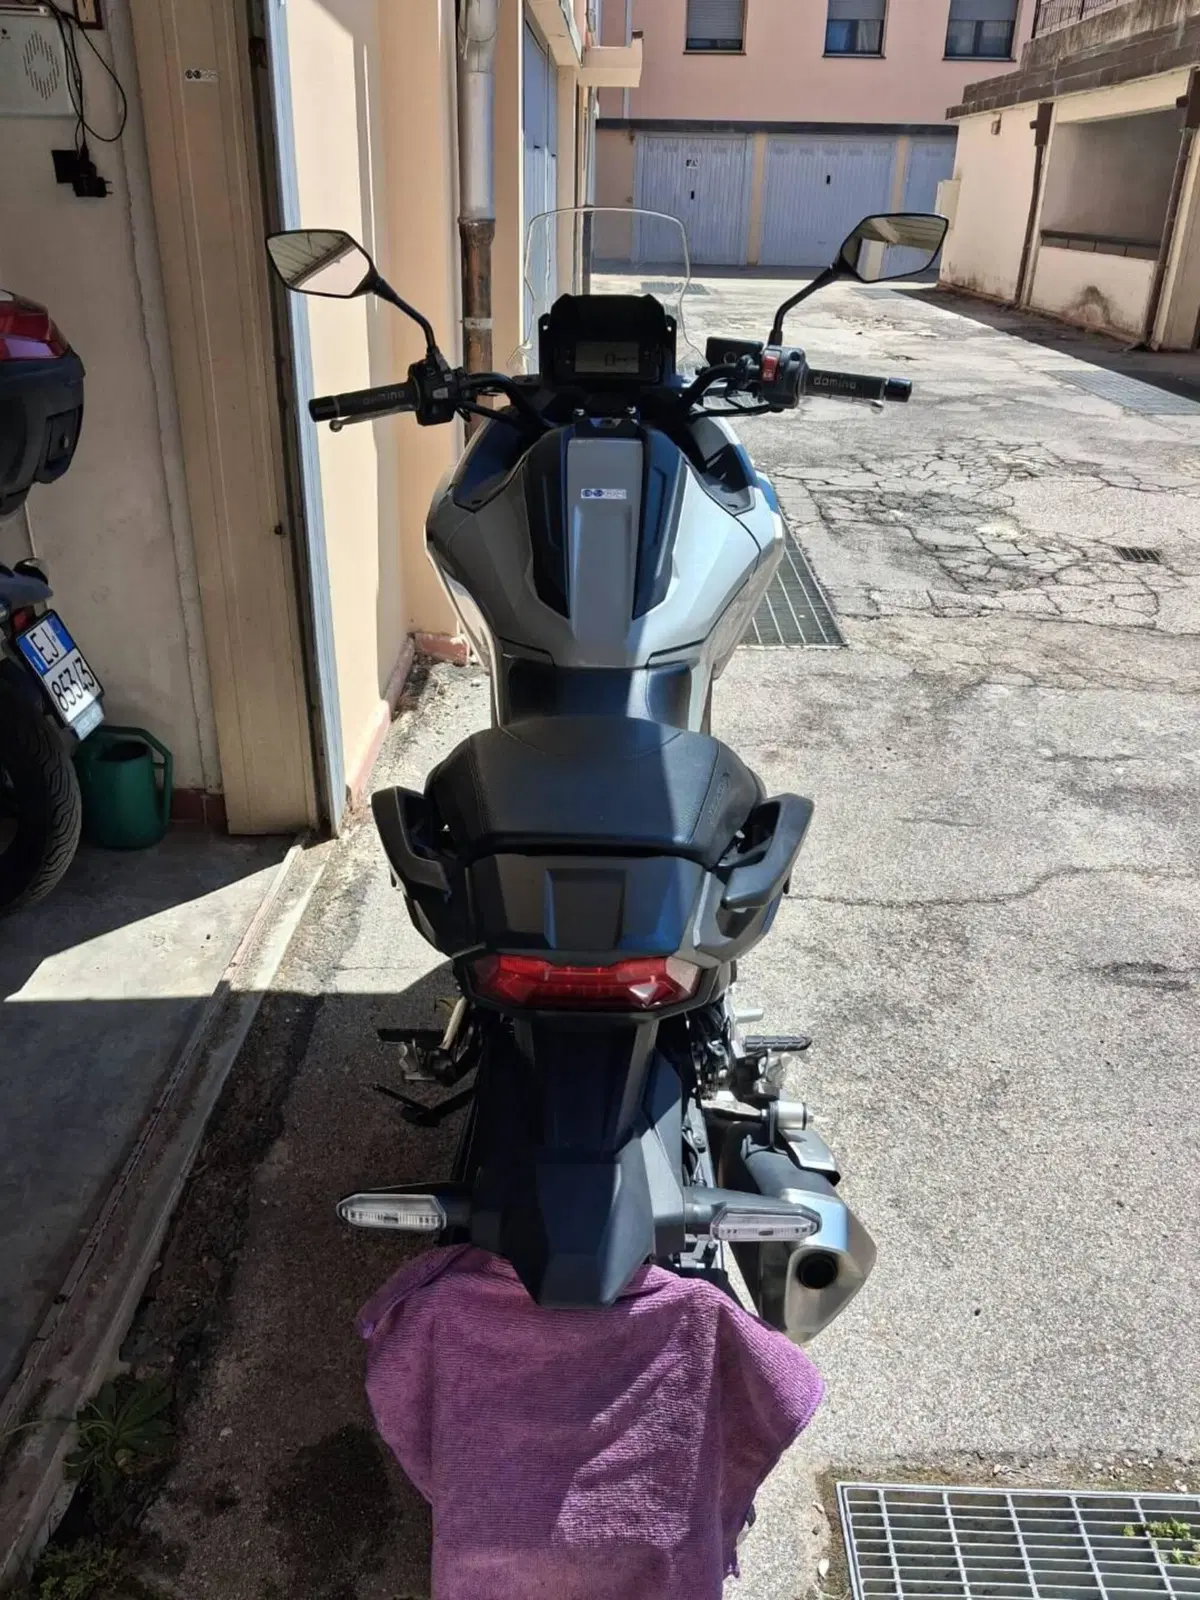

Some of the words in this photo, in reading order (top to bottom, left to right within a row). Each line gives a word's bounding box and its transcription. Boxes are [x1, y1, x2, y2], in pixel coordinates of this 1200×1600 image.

[814, 375, 857, 390] domino
[30, 627, 59, 665] EJ
[51, 657, 95, 712] 85343
